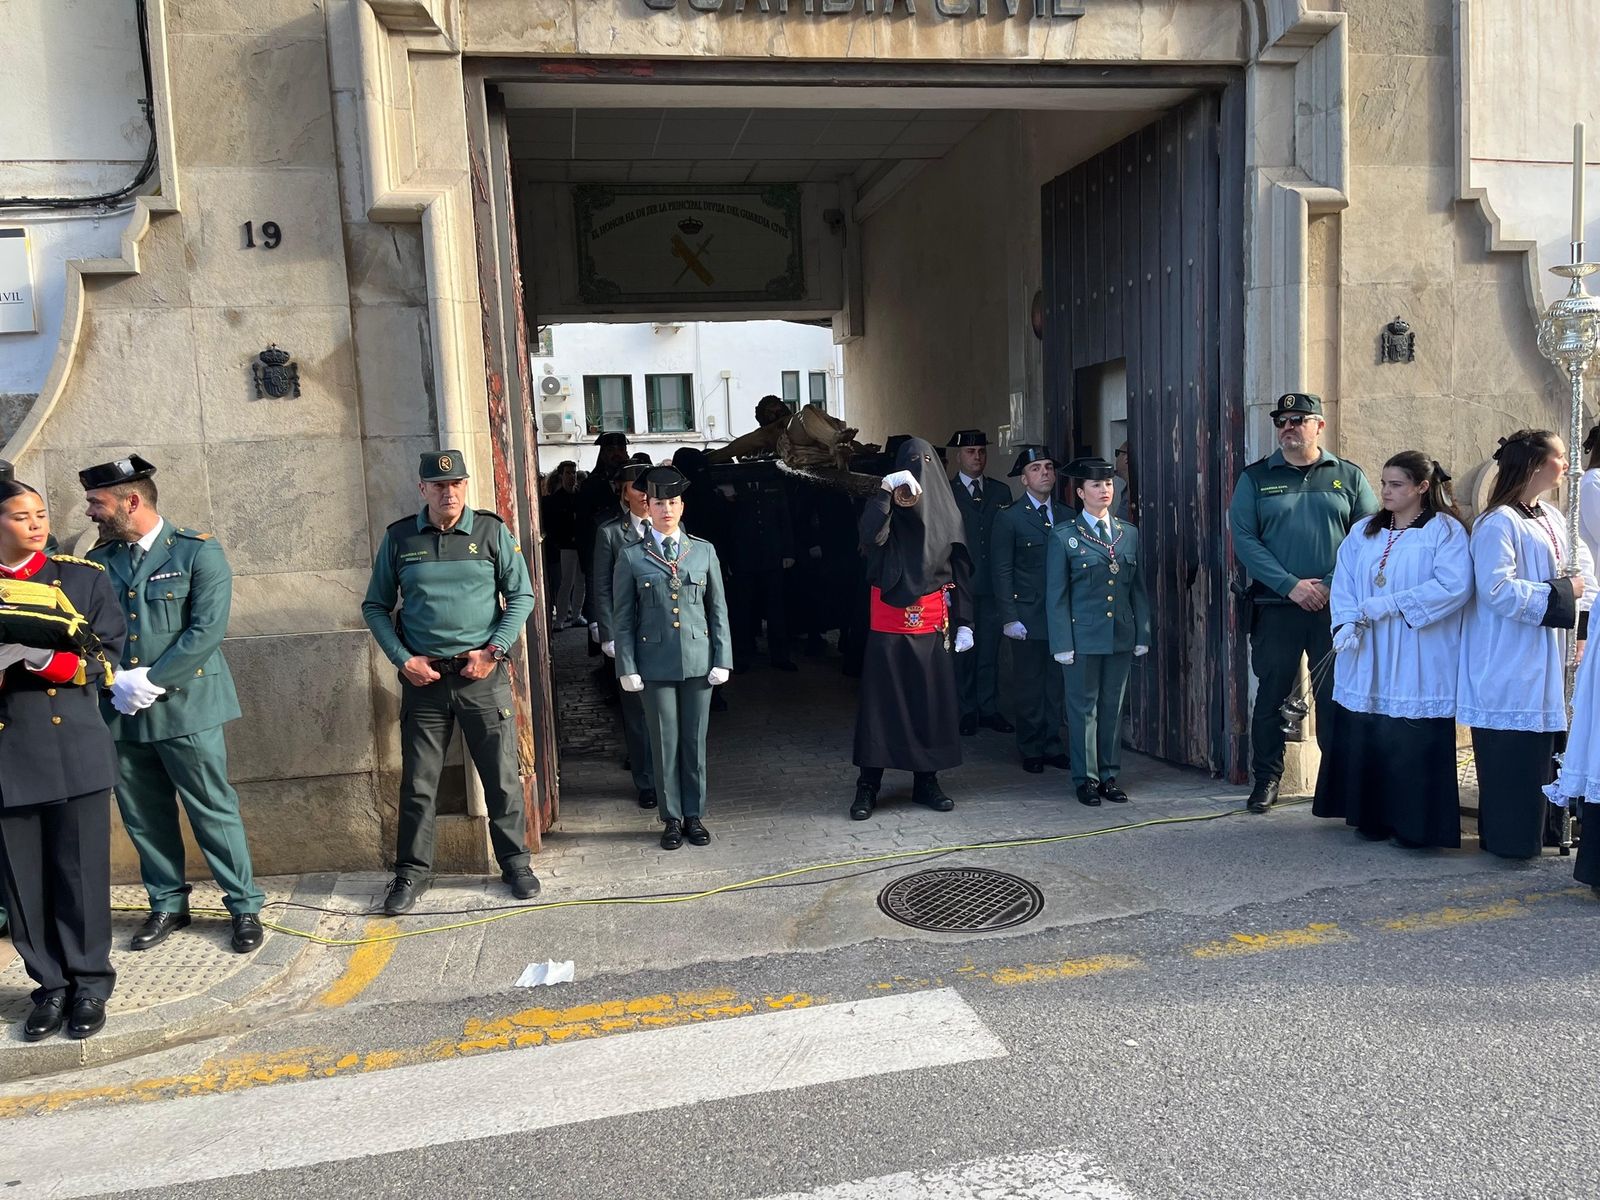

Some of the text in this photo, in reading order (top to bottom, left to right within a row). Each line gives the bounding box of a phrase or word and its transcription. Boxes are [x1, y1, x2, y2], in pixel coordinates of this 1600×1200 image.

[244, 220, 282, 249] 19
[658, 202, 667, 212] LA
[667, 199, 702, 211] PRINCIPAL
[740, 208, 770, 228] GUARDIA
[770, 222, 789, 240] CIVIL
